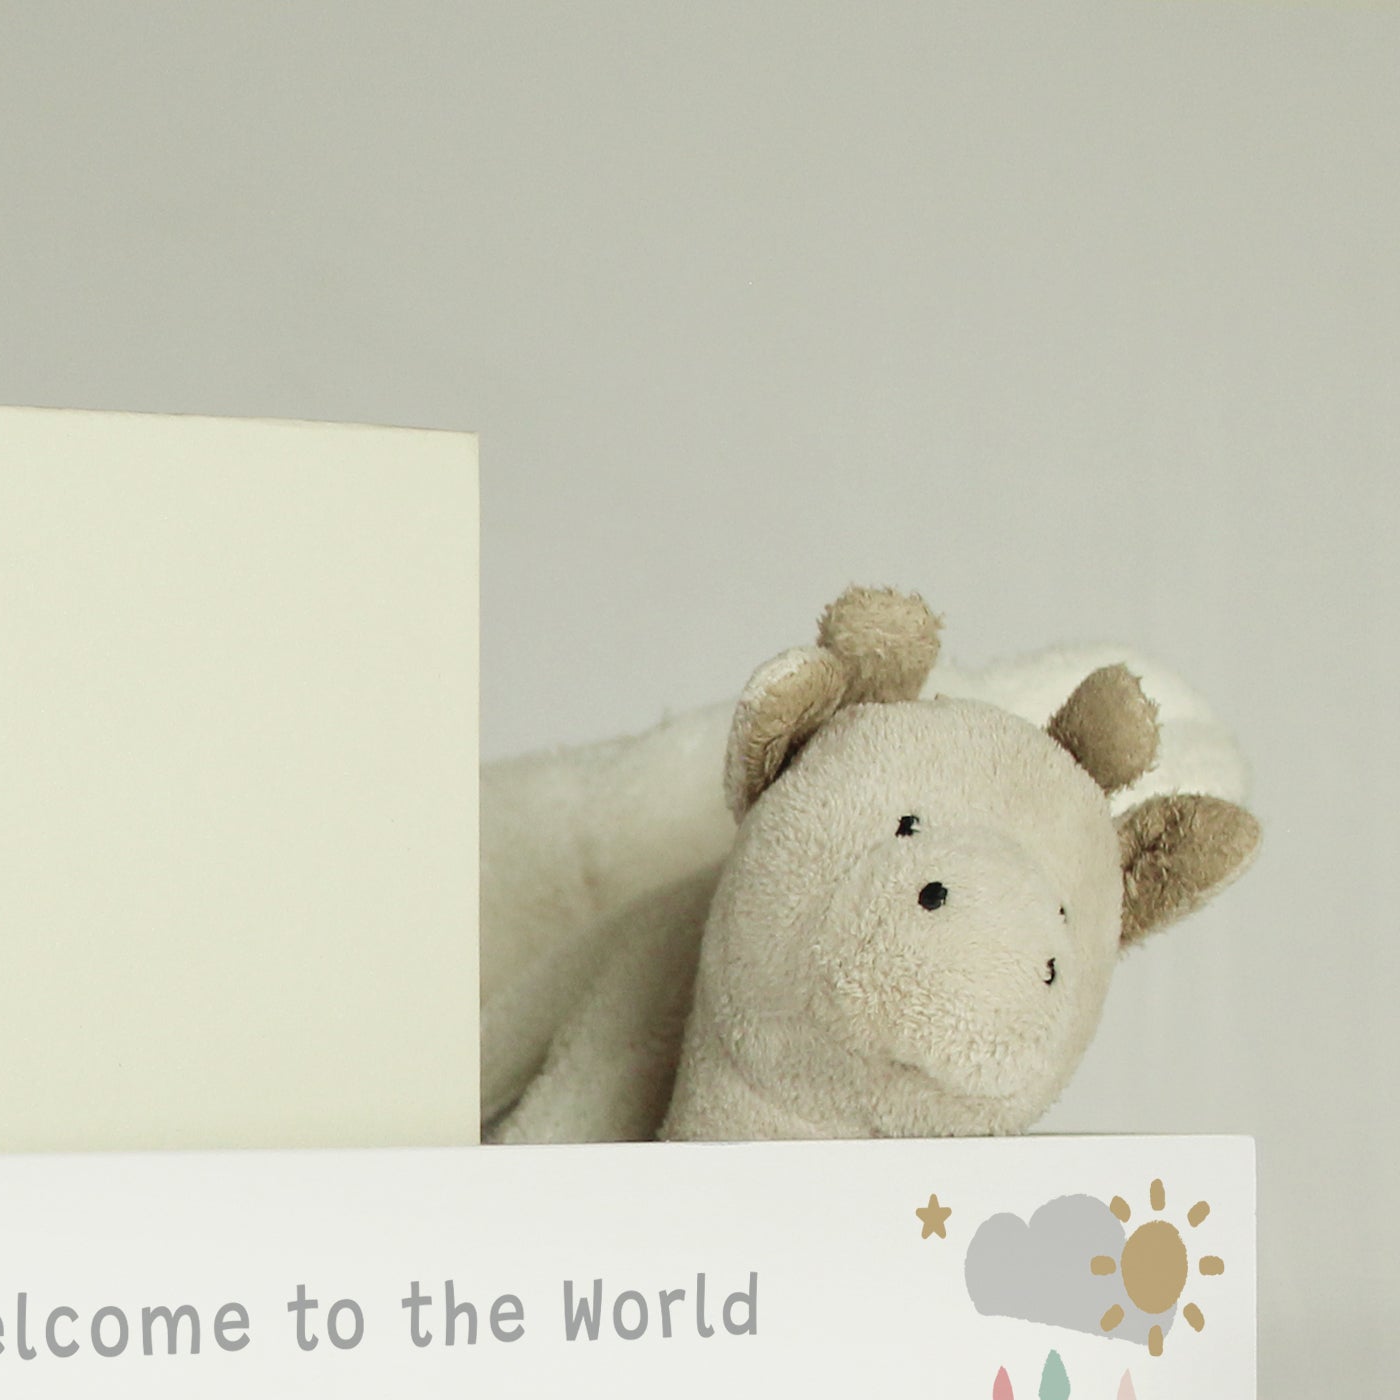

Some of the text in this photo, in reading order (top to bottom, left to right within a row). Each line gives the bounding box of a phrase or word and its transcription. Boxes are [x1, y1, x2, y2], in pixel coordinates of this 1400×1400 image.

[288, 1284, 365, 1352] to
[402, 1280, 525, 1347] the
[563, 1271, 759, 1342] World
